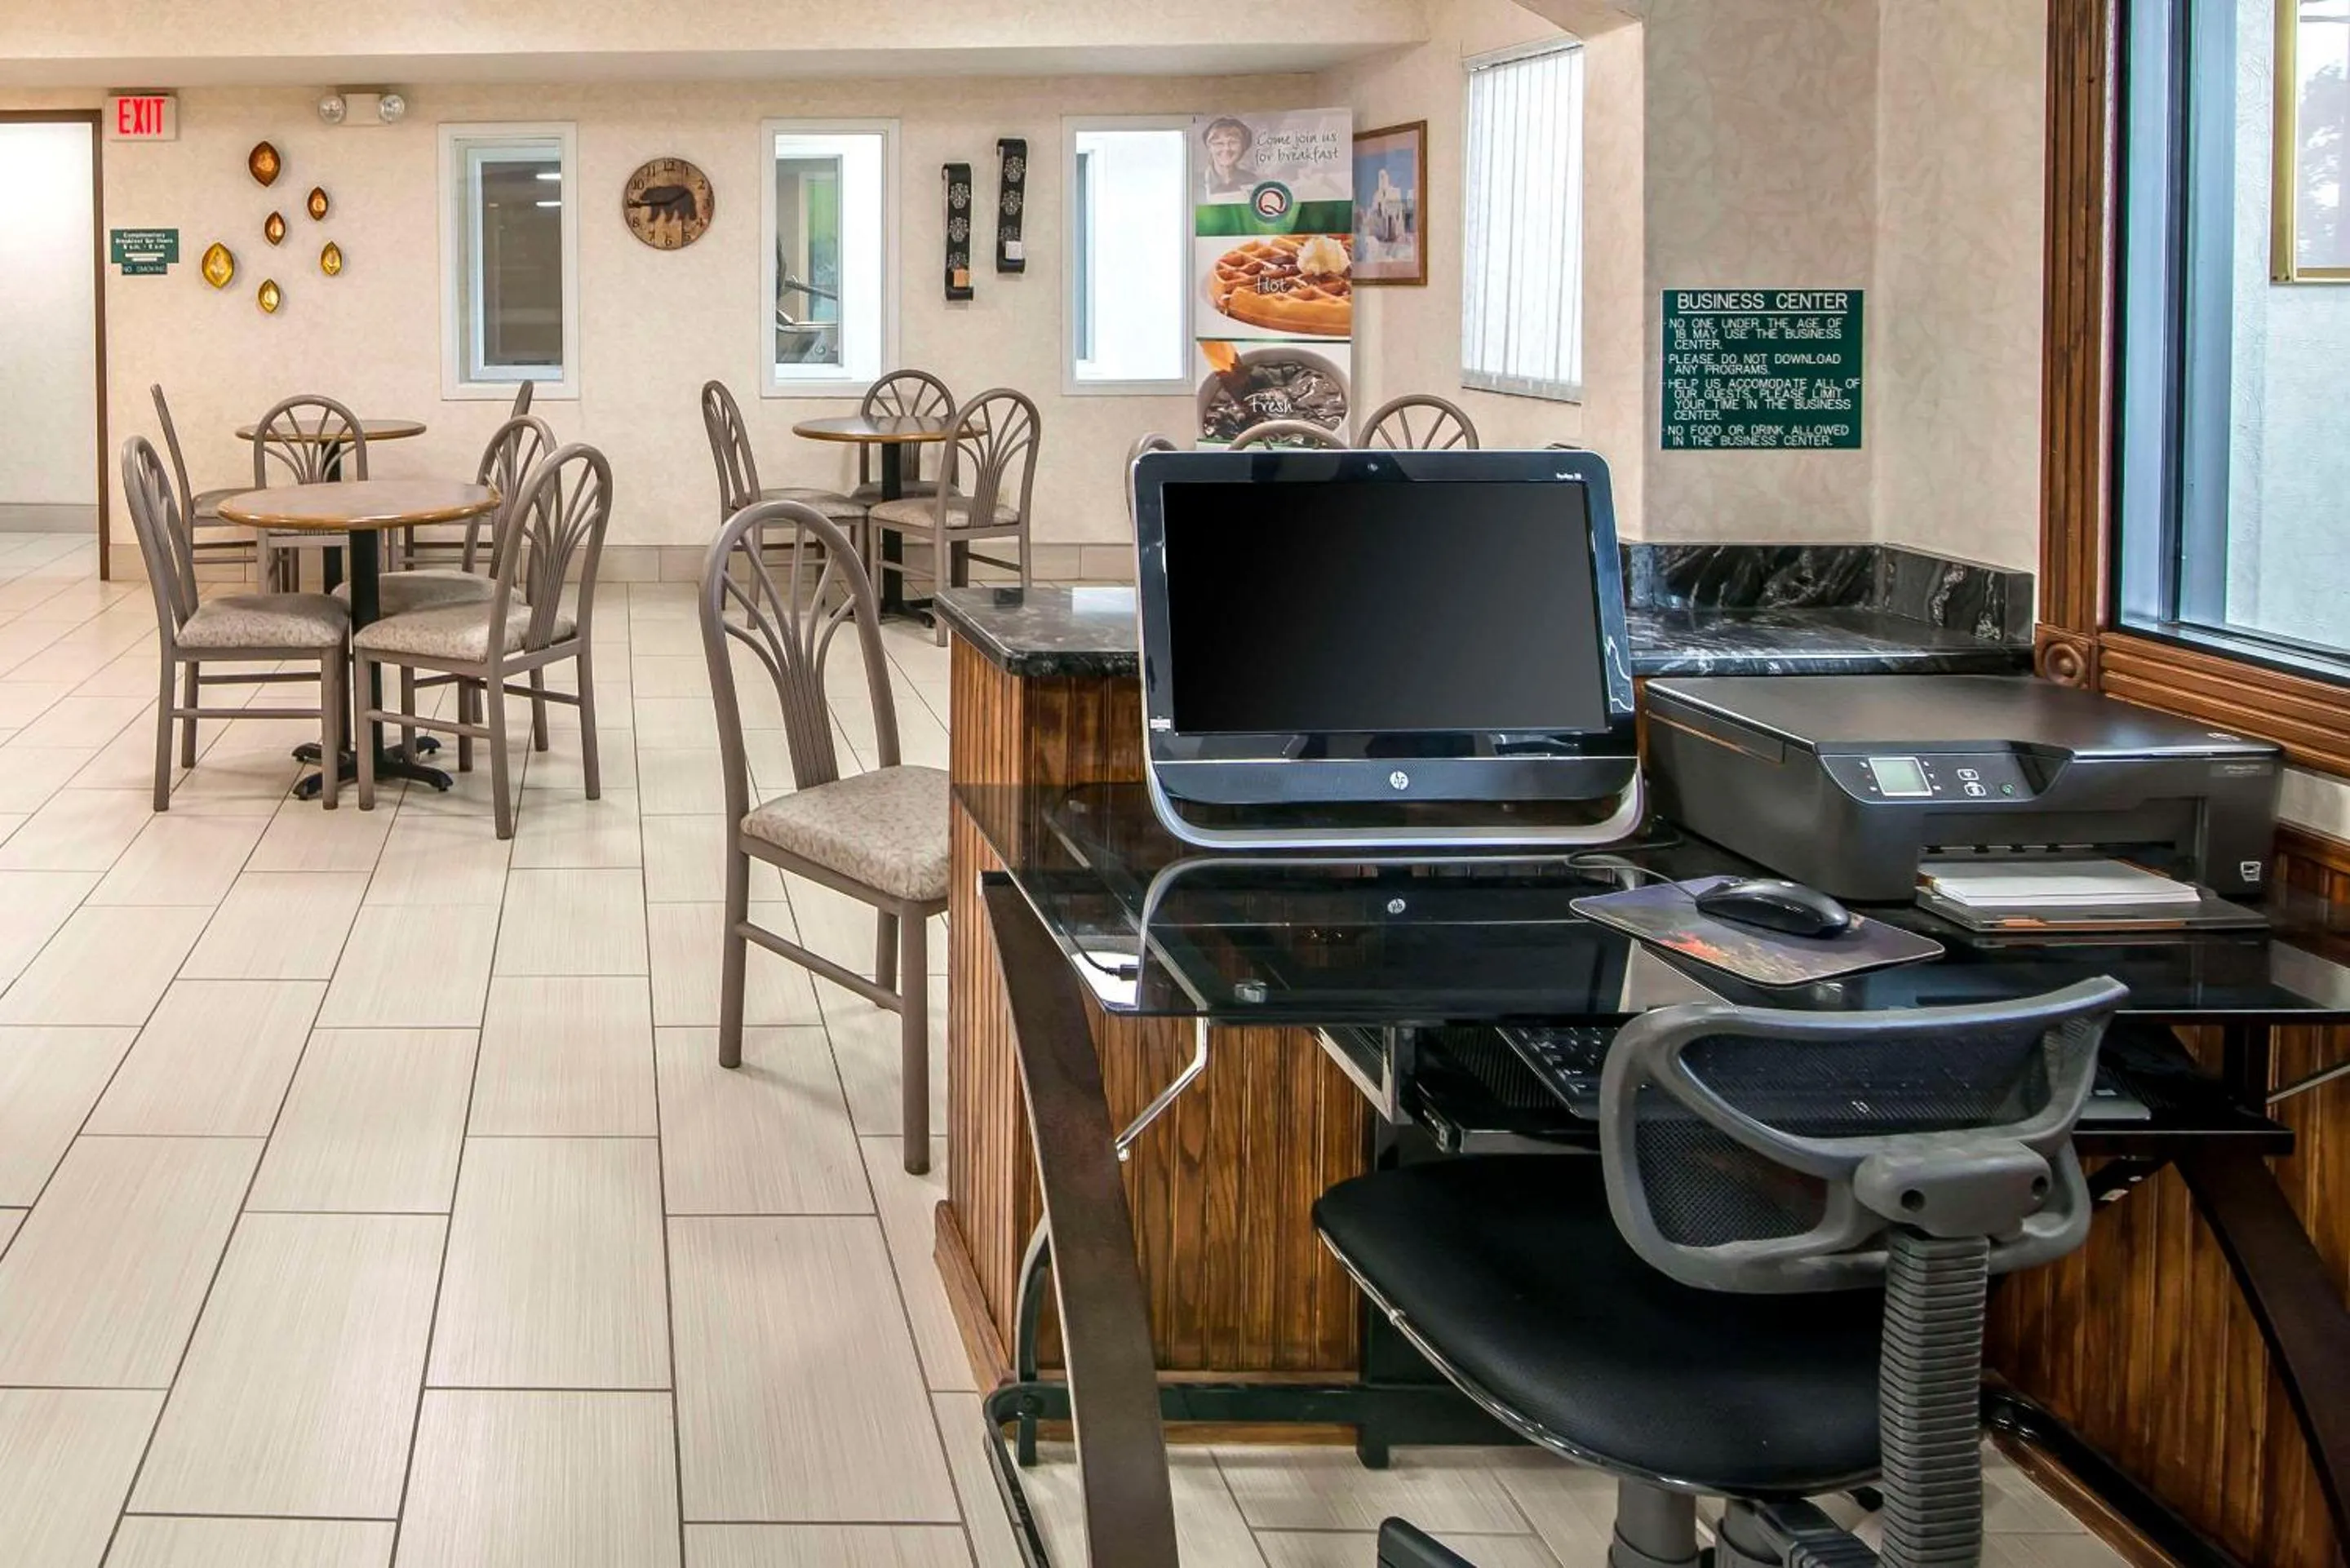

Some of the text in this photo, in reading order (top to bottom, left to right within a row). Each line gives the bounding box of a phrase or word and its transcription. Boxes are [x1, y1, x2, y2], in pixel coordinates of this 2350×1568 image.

[118, 99, 165, 135] EXIT
[1257, 131, 1337, 150] Come join us
[1255, 146, 1338, 165] for breakfast
[663, 161, 676, 171] 12
[697, 179, 706, 189] 2
[1257, 189, 1287, 215] Q
[1677, 292, 1848, 310] BUSINESS CENTER
[1669, 317, 1843, 329] NO ONE UNDER THE AGE OF
[1675, 328, 1842, 339] 18 MAY USE THE BUSINESS
[1674, 339, 1723, 350] CENTER.
[1669, 353, 1842, 365] PLEASE DO NOT DOWNLOAD
[1674, 364, 1771, 375] ANY PROGRAMS.
[1668, 378, 1860, 389] HELP US ACCOMODATE ALL OF
[1674, 388, 1698, 400] OUR
[1759, 388, 1805, 399] PLEASE
[1811, 388, 1842, 399] LIMIT
[1244, 393, 1293, 414] Fresh
[1675, 399, 1851, 410] YOUR TIME IN THE BUSINESS
[1674, 410, 1723, 421] CENTER.
[1667, 424, 1850, 436] NO FOOD OR DRINK ALLOWED
[1673, 435, 1833, 446] IN THE BUSINESS CENTER.
